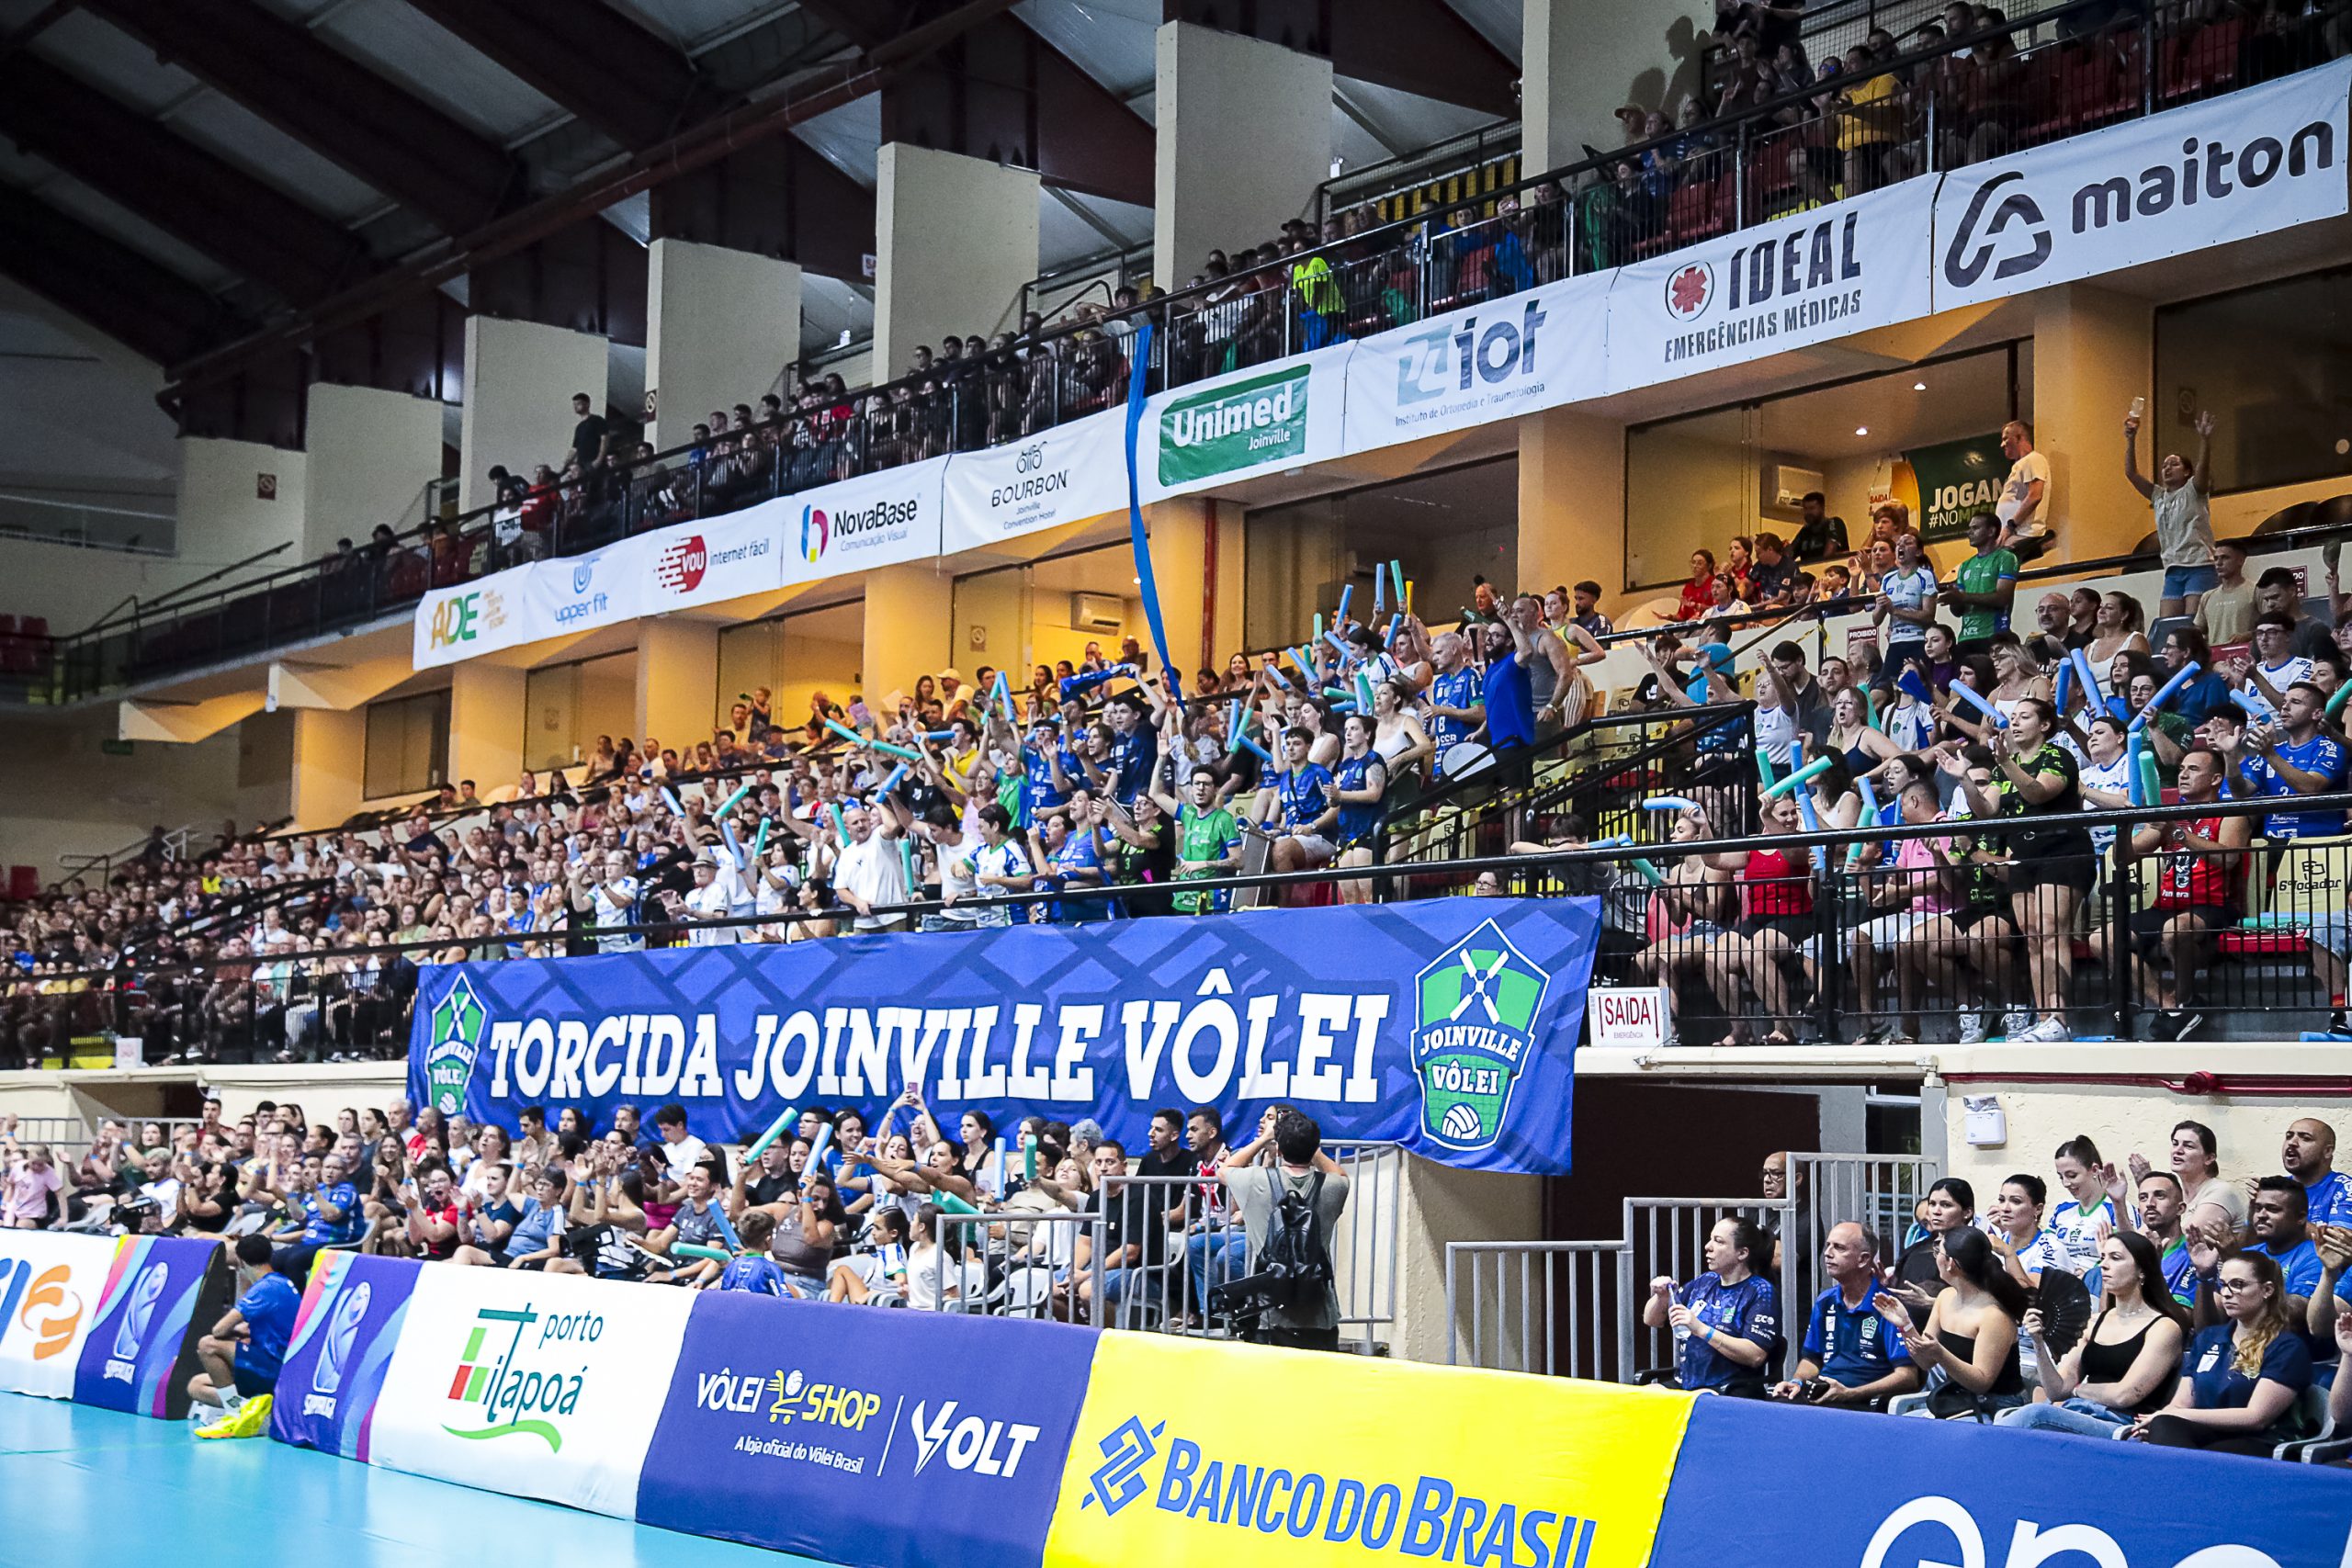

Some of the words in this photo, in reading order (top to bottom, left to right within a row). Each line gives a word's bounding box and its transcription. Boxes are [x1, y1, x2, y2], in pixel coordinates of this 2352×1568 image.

[2072, 120, 2334, 235] maiton
[1728, 210, 1861, 311] IDEAL
[1453, 299, 1548, 391] iot
[1664, 311, 1777, 364] EMERGÊNCIAS
[1784, 288, 1861, 333] MÉDICAS
[1173, 381, 1293, 447] Unimed
[1429, 407, 1439, 420] de
[1248, 428, 1291, 451] Joinville
[991, 469, 1068, 507] BOURBON
[833, 499, 918, 538] NovaBase
[709, 546, 748, 566] internet
[749, 538, 770, 557] fácil
[431, 592, 481, 650] ADE
[555, 601, 591, 626] upper
[593, 592, 608, 615] fit
[1604, 996, 1651, 1025] SAÍDA
[490, 1012, 724, 1099] TORCIDA
[734, 1003, 1104, 1101] JOINVILLE
[1121, 967, 1390, 1104] VÔLEI
[1419, 1025, 1522, 1062] JOINVILLE
[1431, 1059, 1498, 1094] VÔLEI
[538, 1309, 604, 1349] porto
[695, 1367, 765, 1414] VÔLEI
[801, 1383, 881, 1432] SHOP
[734, 1436, 744, 1450] A
[743, 1436, 763, 1456] loja
[763, 1438, 796, 1459] oficial
[792, 1442, 808, 1461] do
[808, 1446, 836, 1466] Vôlei
[832, 1451, 865, 1474] Brasil
[910, 1398, 1041, 1478] VOLT
[1156, 1437, 1325, 1539] BANCO
[1324, 1478, 1402, 1551] DO
